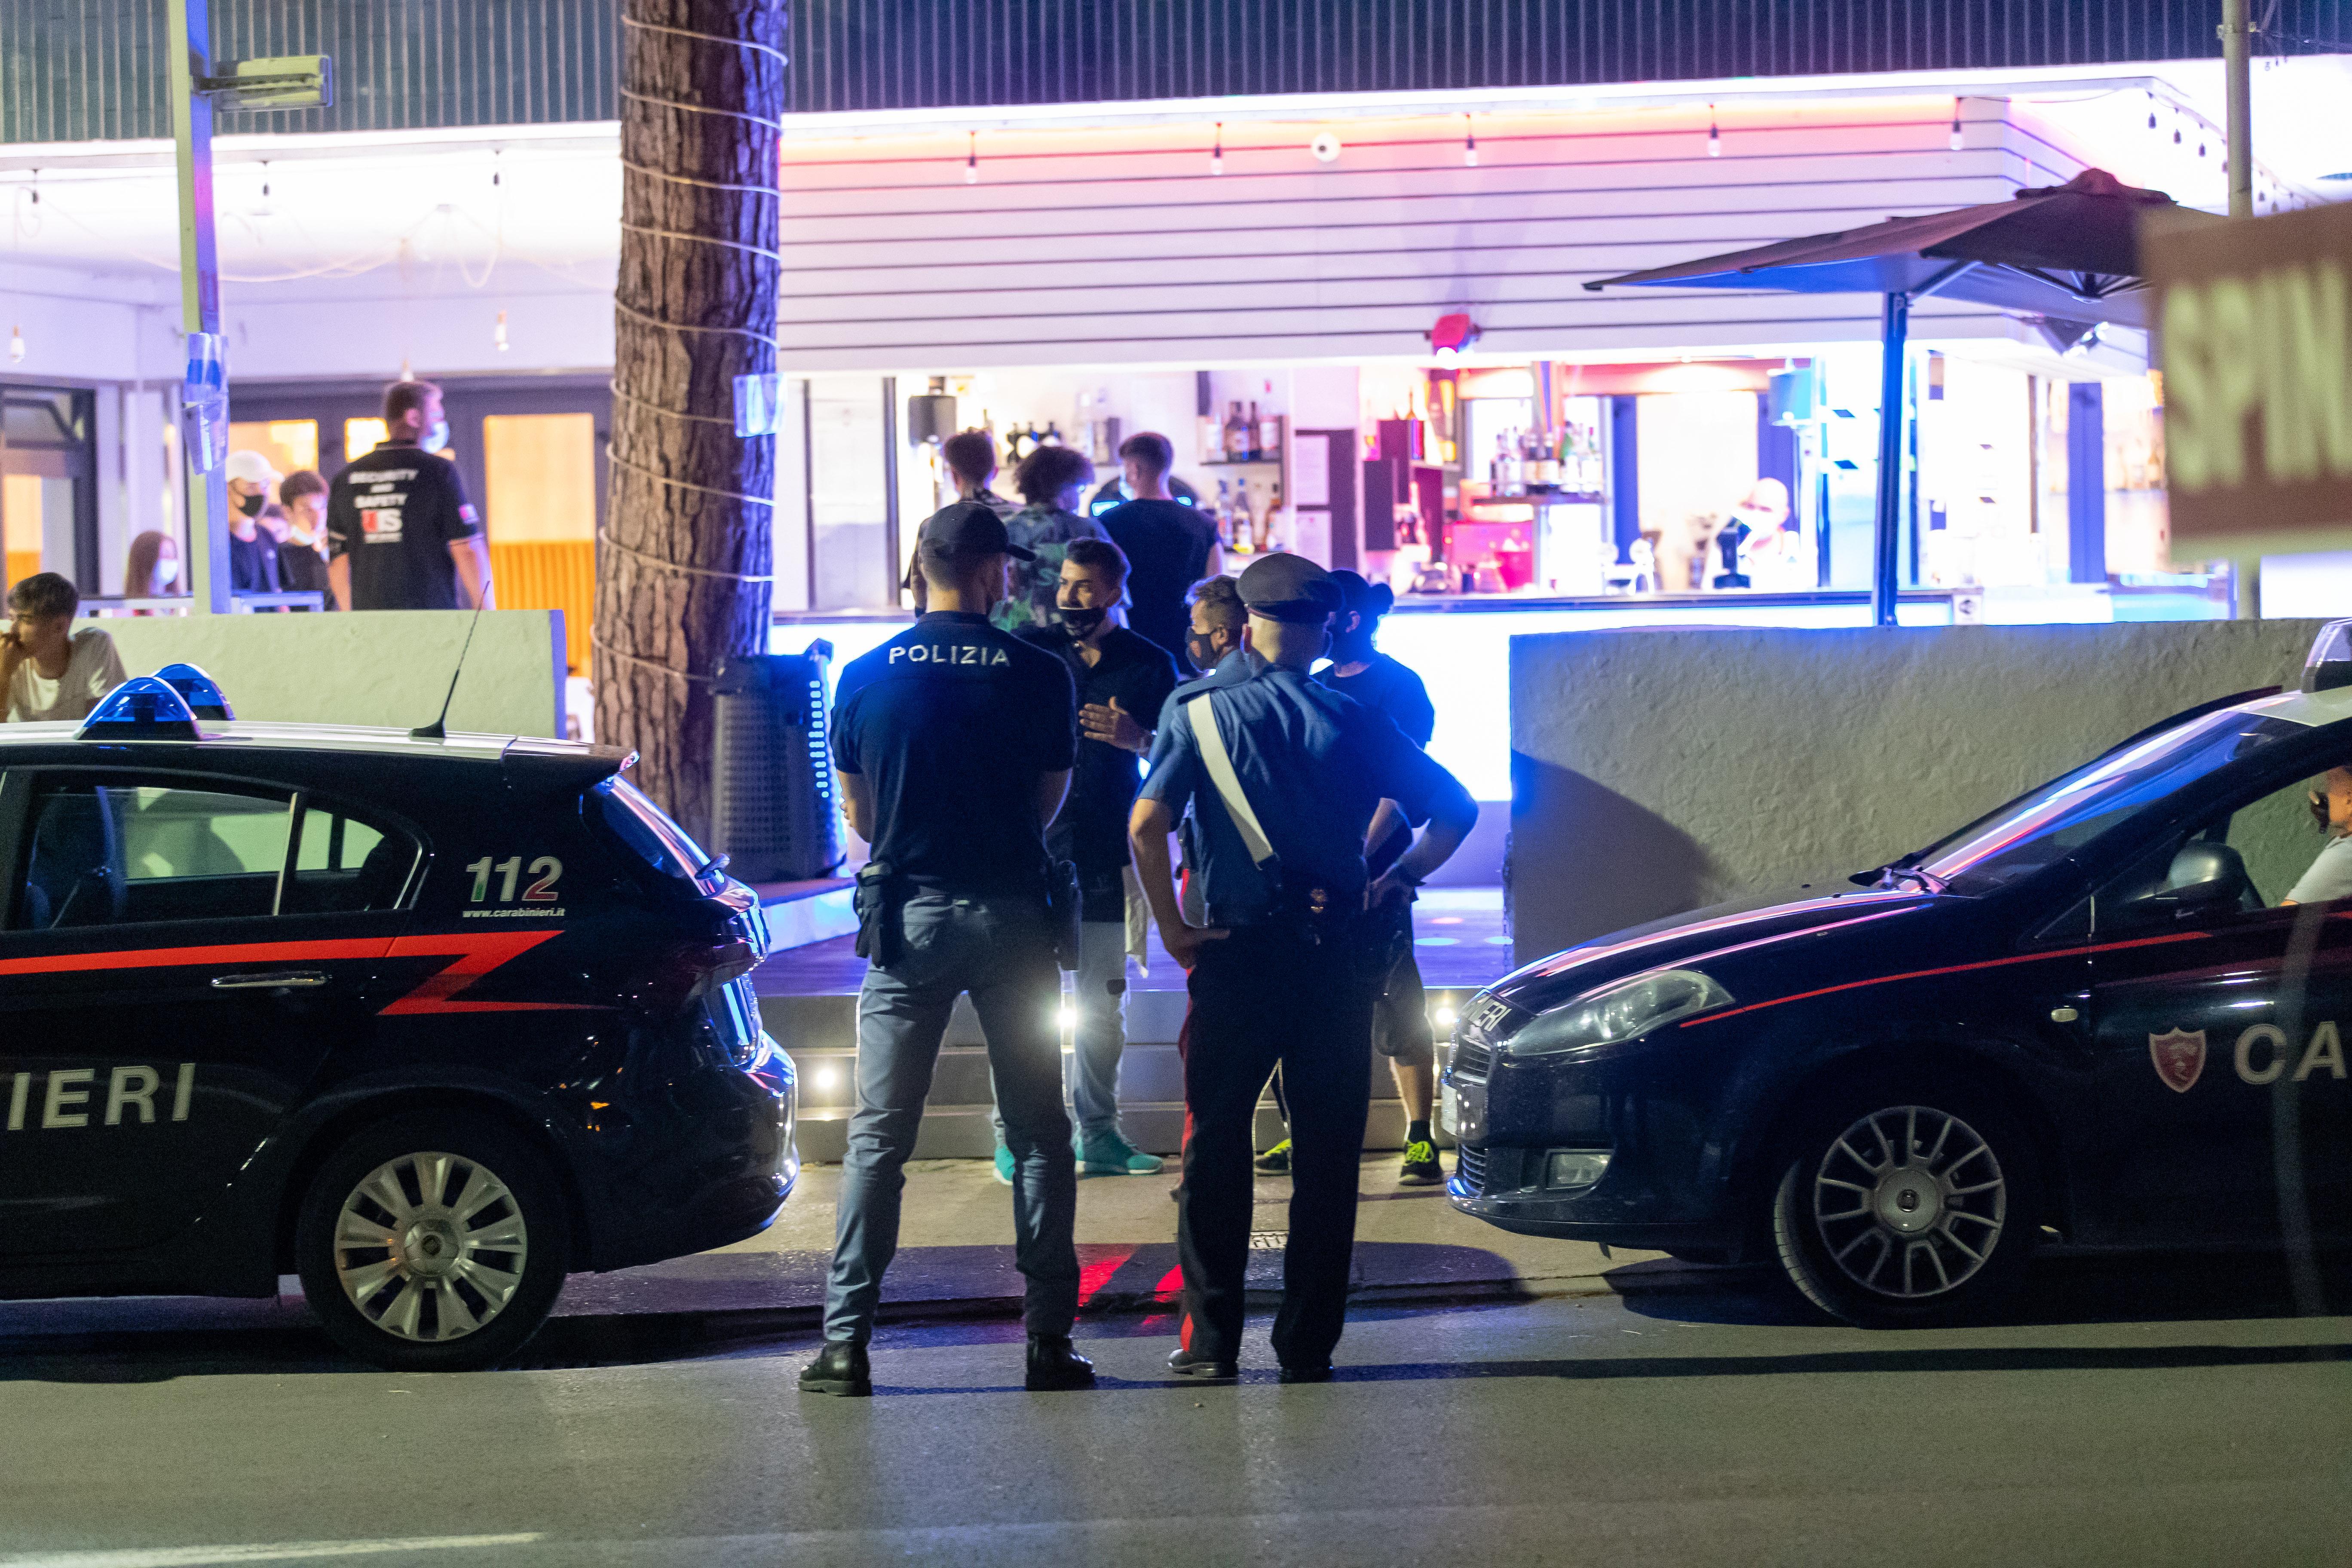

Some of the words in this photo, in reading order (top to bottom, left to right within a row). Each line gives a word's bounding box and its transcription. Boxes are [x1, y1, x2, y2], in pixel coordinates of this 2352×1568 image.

[888, 645, 1011, 667] POLIZIA
[466, 856, 563, 902] 112
[462, 908, 565, 918] www.carabinieri.it
[2235, 1020, 2347, 1085] CA
[7, 1063, 196, 1130] IERI
